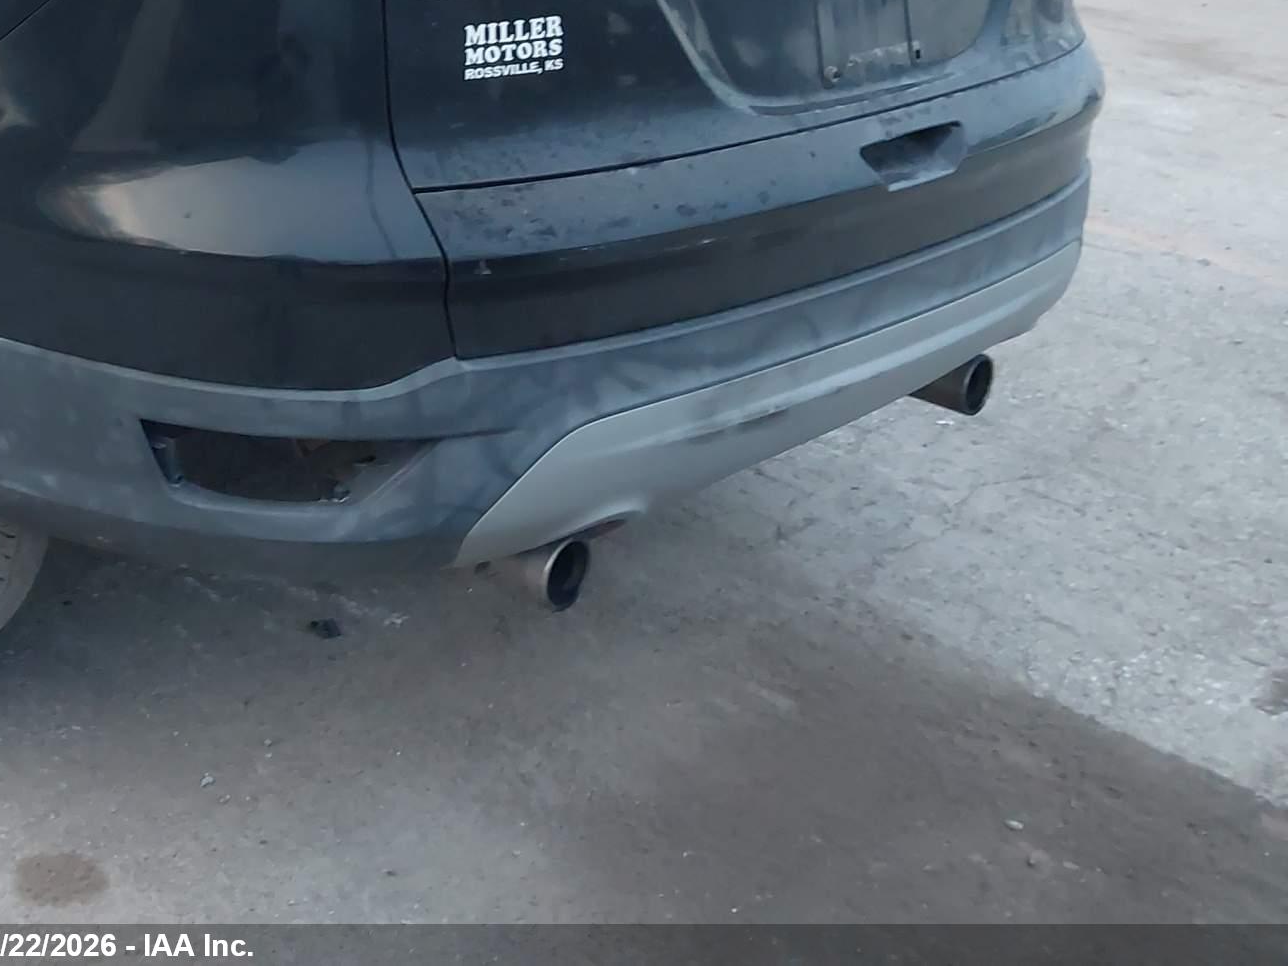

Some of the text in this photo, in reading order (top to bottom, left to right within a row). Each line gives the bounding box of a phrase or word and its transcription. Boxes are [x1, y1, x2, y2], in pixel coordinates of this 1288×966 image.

[464, 15, 564, 47] MILLER
[464, 38, 563, 66] MOTORS
[464, 58, 564, 81] ROSSVILLE, KS
